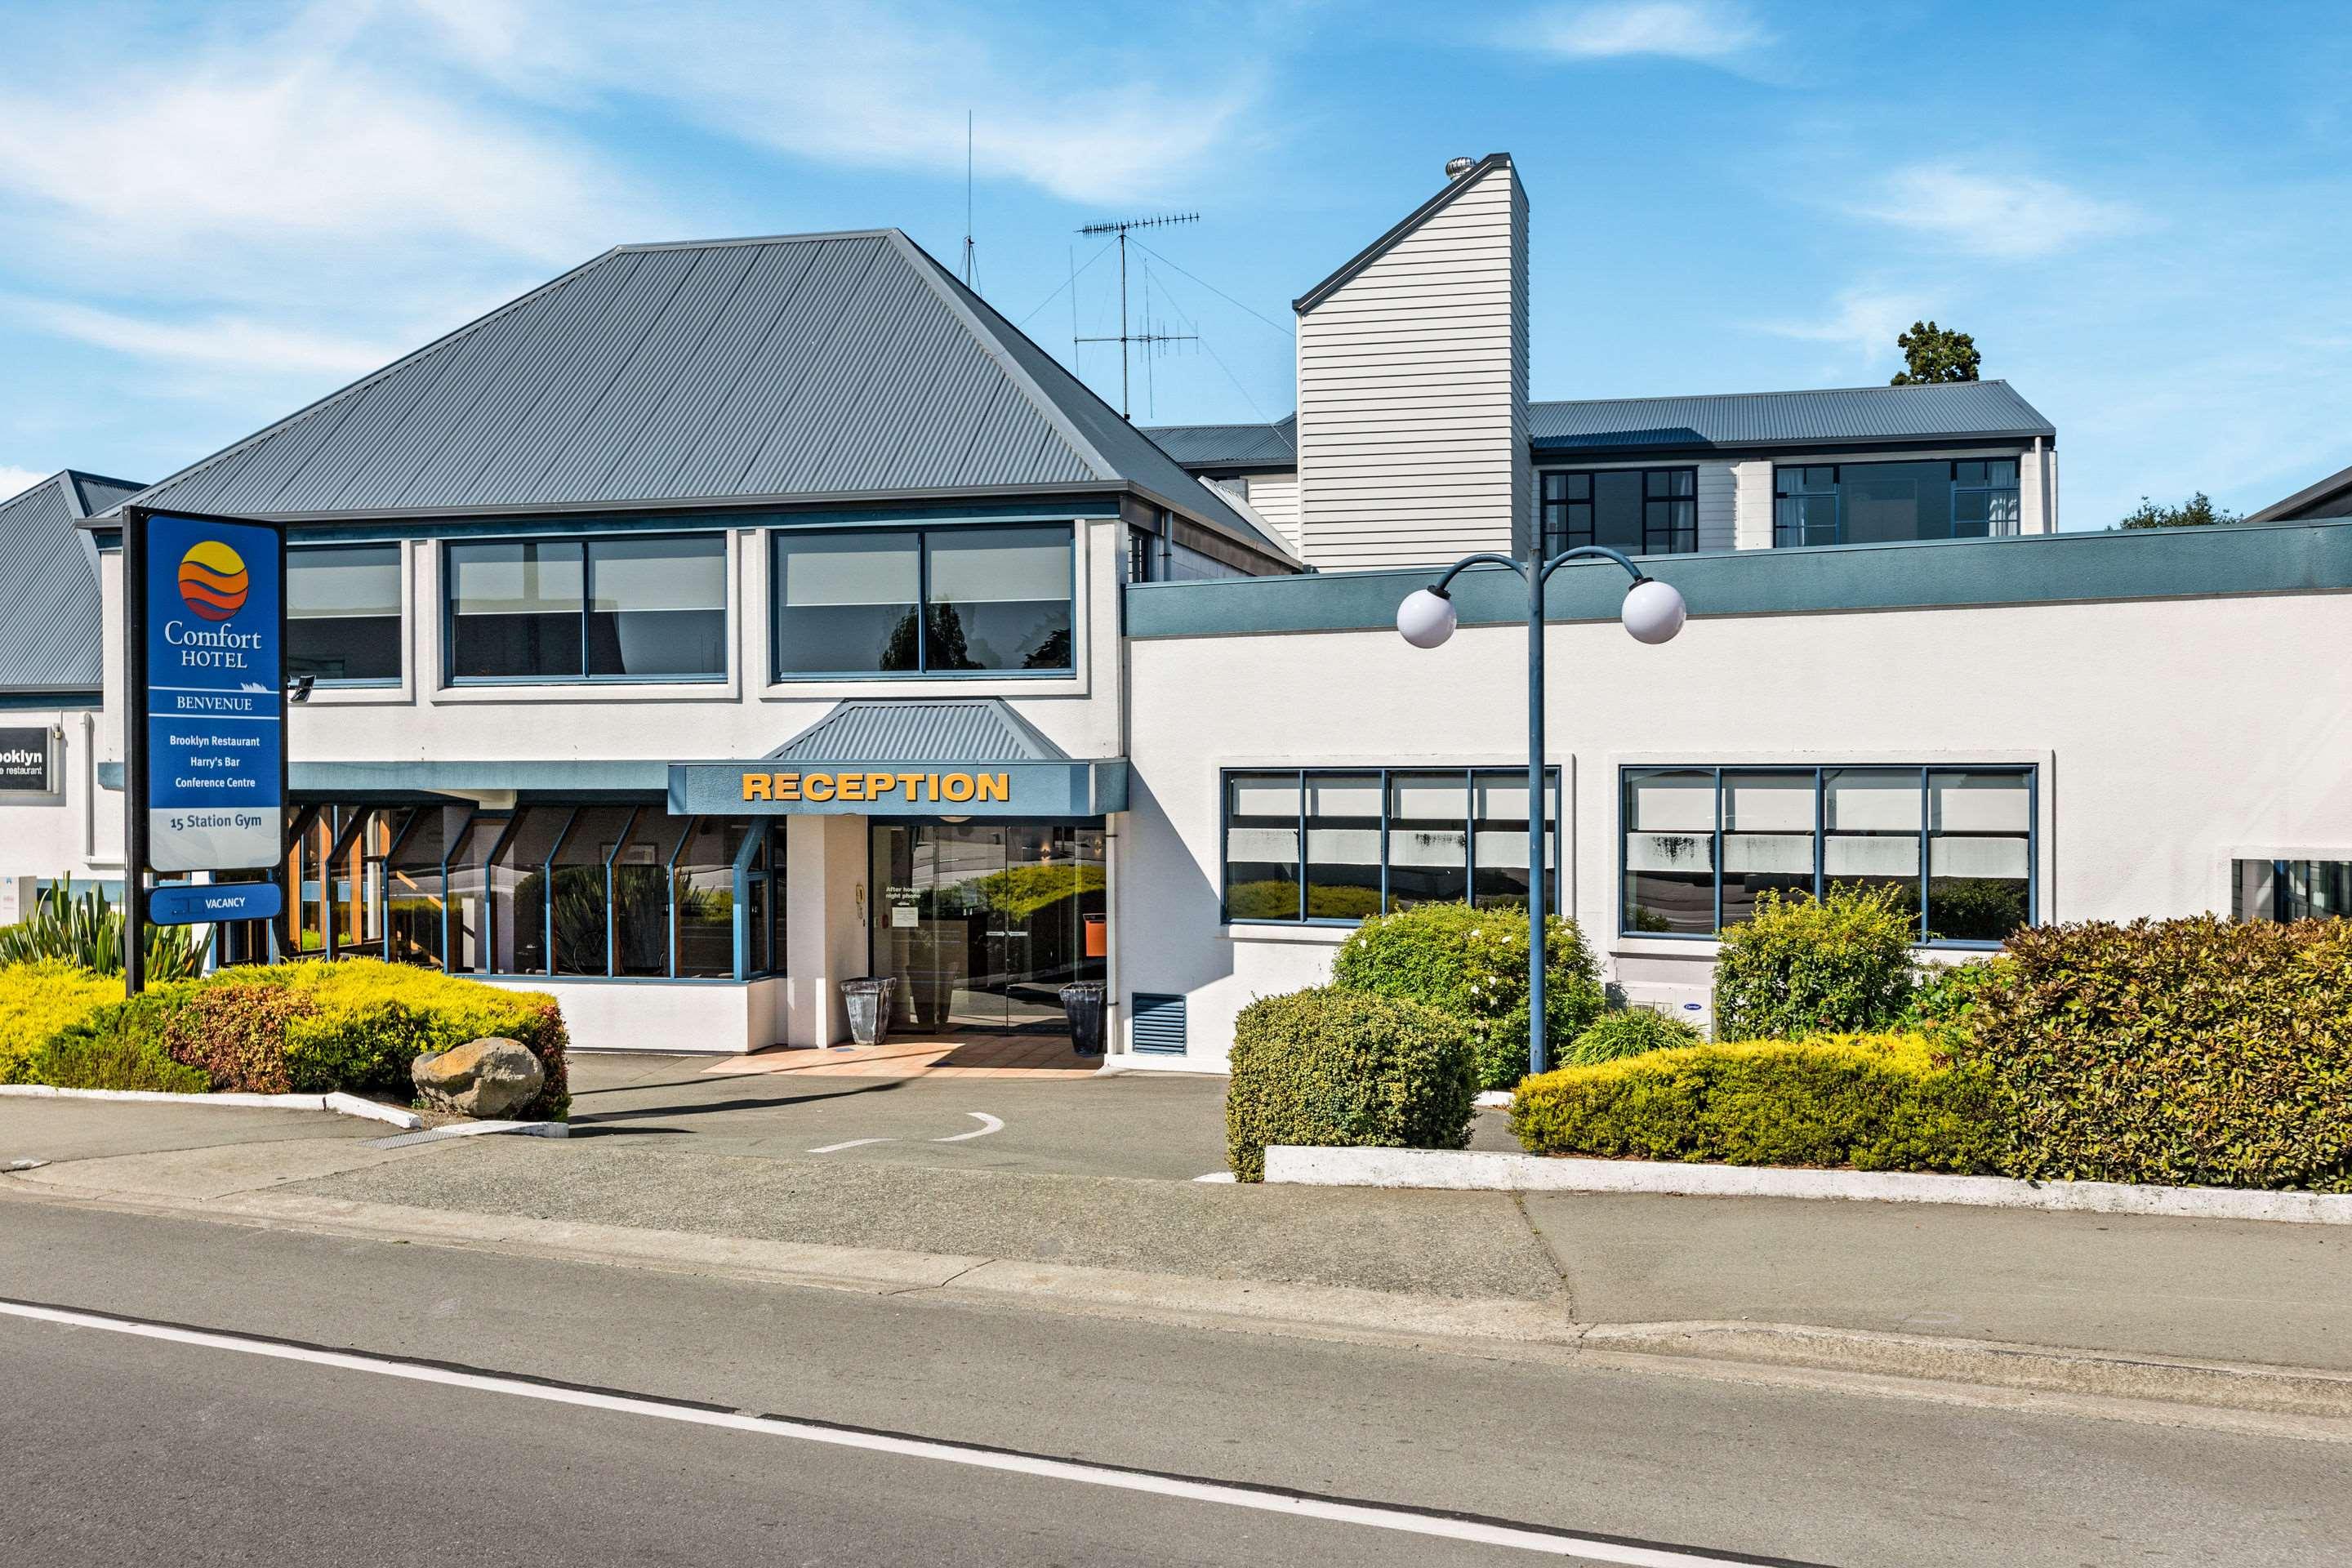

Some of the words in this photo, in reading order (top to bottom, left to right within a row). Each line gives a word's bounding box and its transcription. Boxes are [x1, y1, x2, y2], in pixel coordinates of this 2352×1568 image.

[165, 621, 261, 649] Comfort
[181, 651, 247, 669] HOTEL
[176, 696, 252, 710] BENVENUE
[170, 735, 209, 748] Brooklyn
[212, 736, 260, 746] Restaurant
[190, 757, 223, 768] Harry's
[225, 757, 240, 767] Bar
[7, 766, 42, 775] restaurant
[176, 777, 225, 787] Conference
[227, 777, 256, 787] Centre
[742, 773, 1010, 802] RECEPTION
[170, 817, 184, 831] 15
[187, 815, 232, 828] Station
[234, 813, 262, 829] Gym
[206, 898, 246, 908] VACANCY
